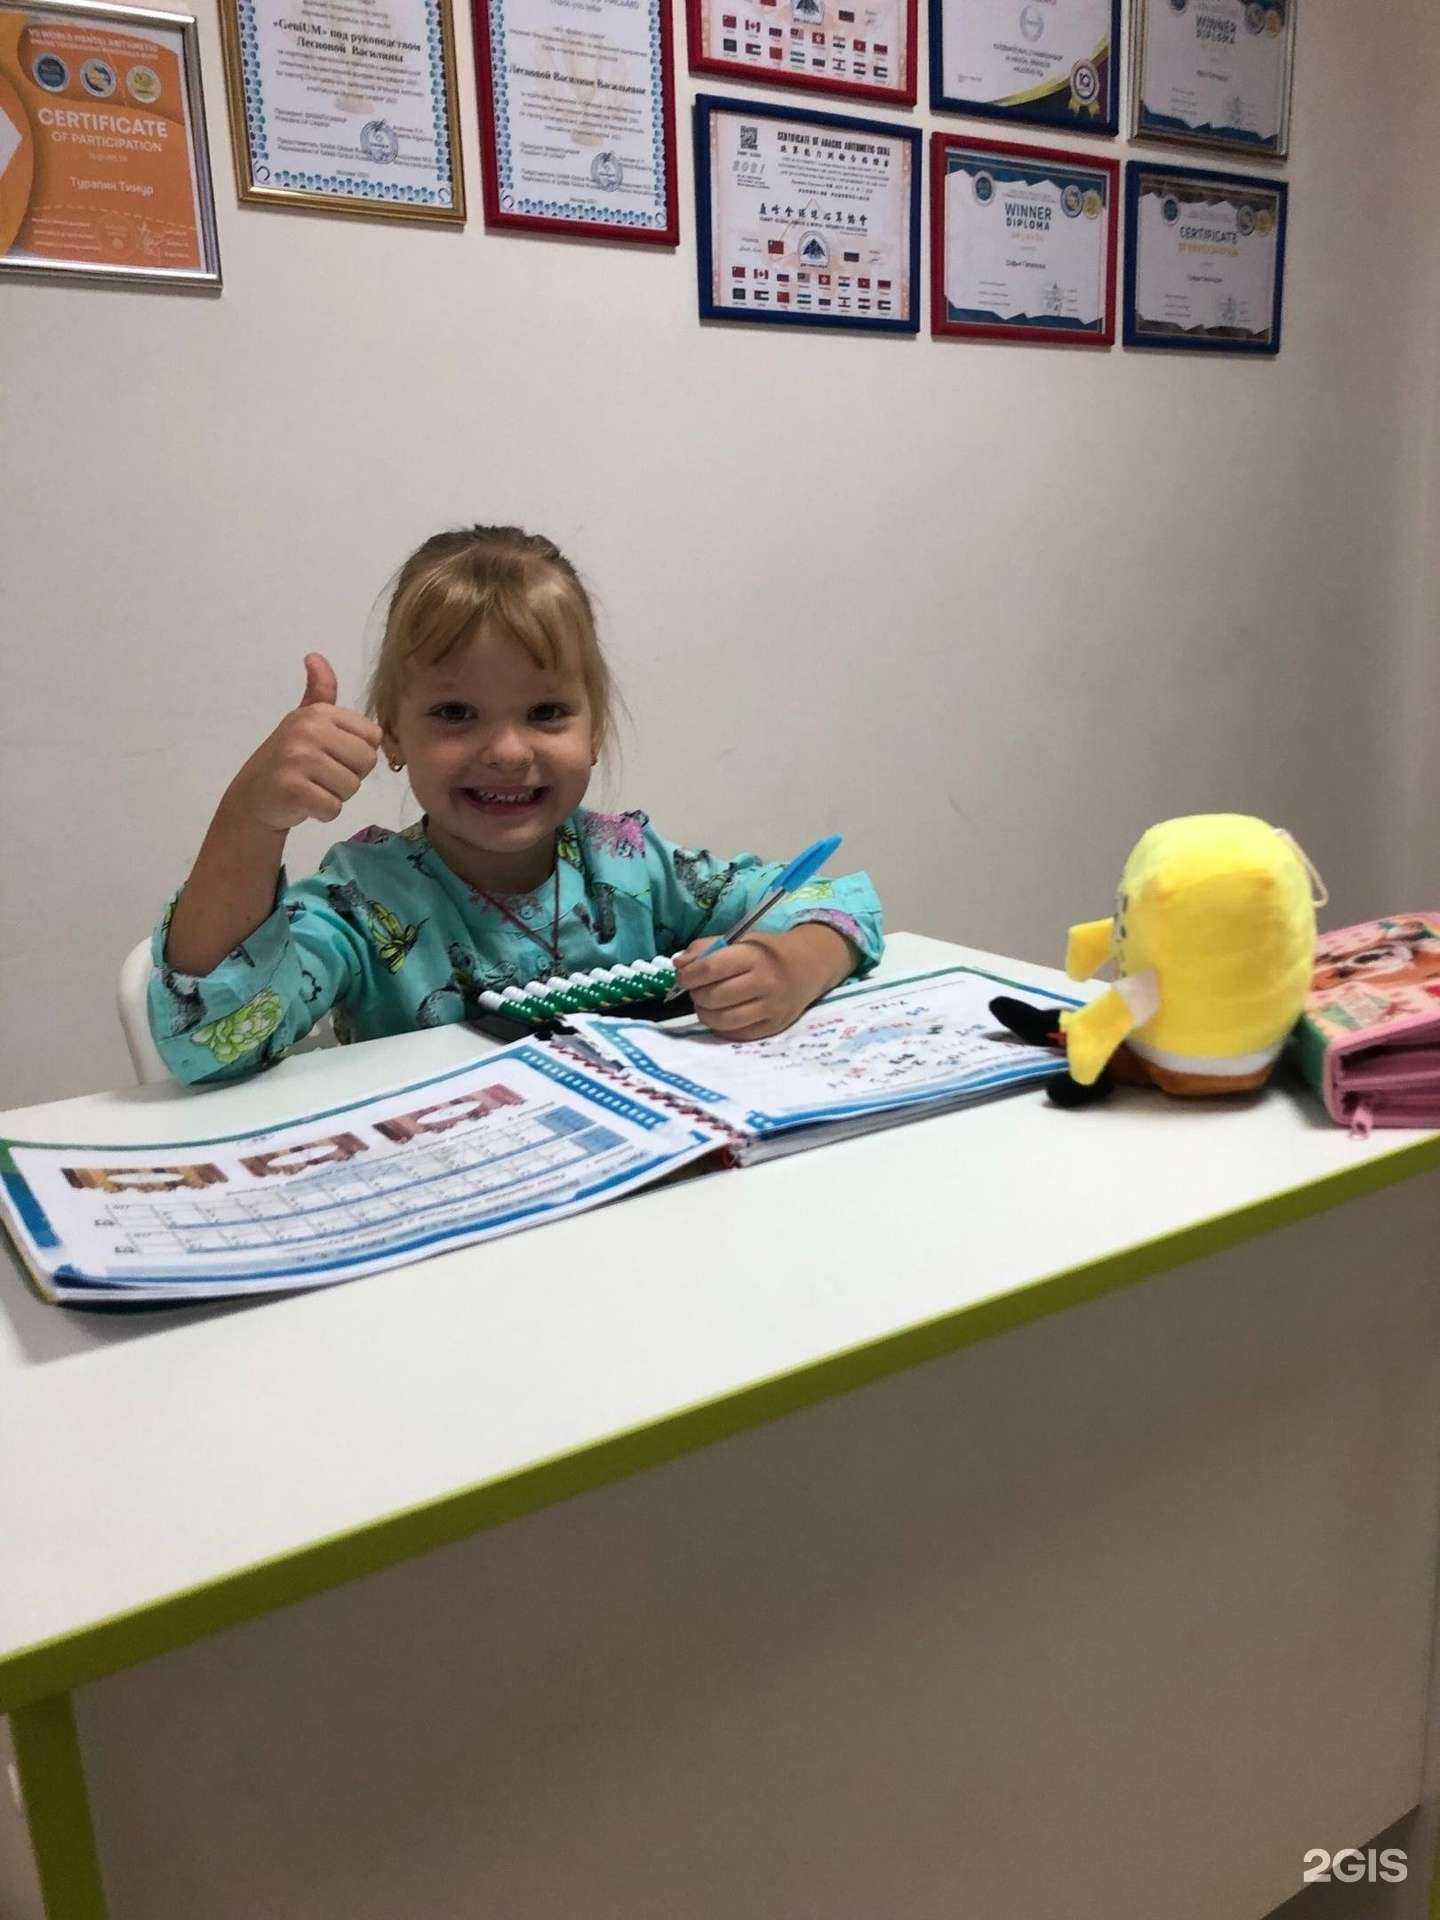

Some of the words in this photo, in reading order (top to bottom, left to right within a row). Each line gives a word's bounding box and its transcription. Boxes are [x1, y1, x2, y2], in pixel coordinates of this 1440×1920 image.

[38, 107, 168, 139] CERTIFICATE
[51, 131, 69, 142] OF
[71, 133, 162, 152] PARTICIPATION
[1004, 203, 1052, 221] WINNER
[1006, 217, 1050, 232] DIPLOMA
